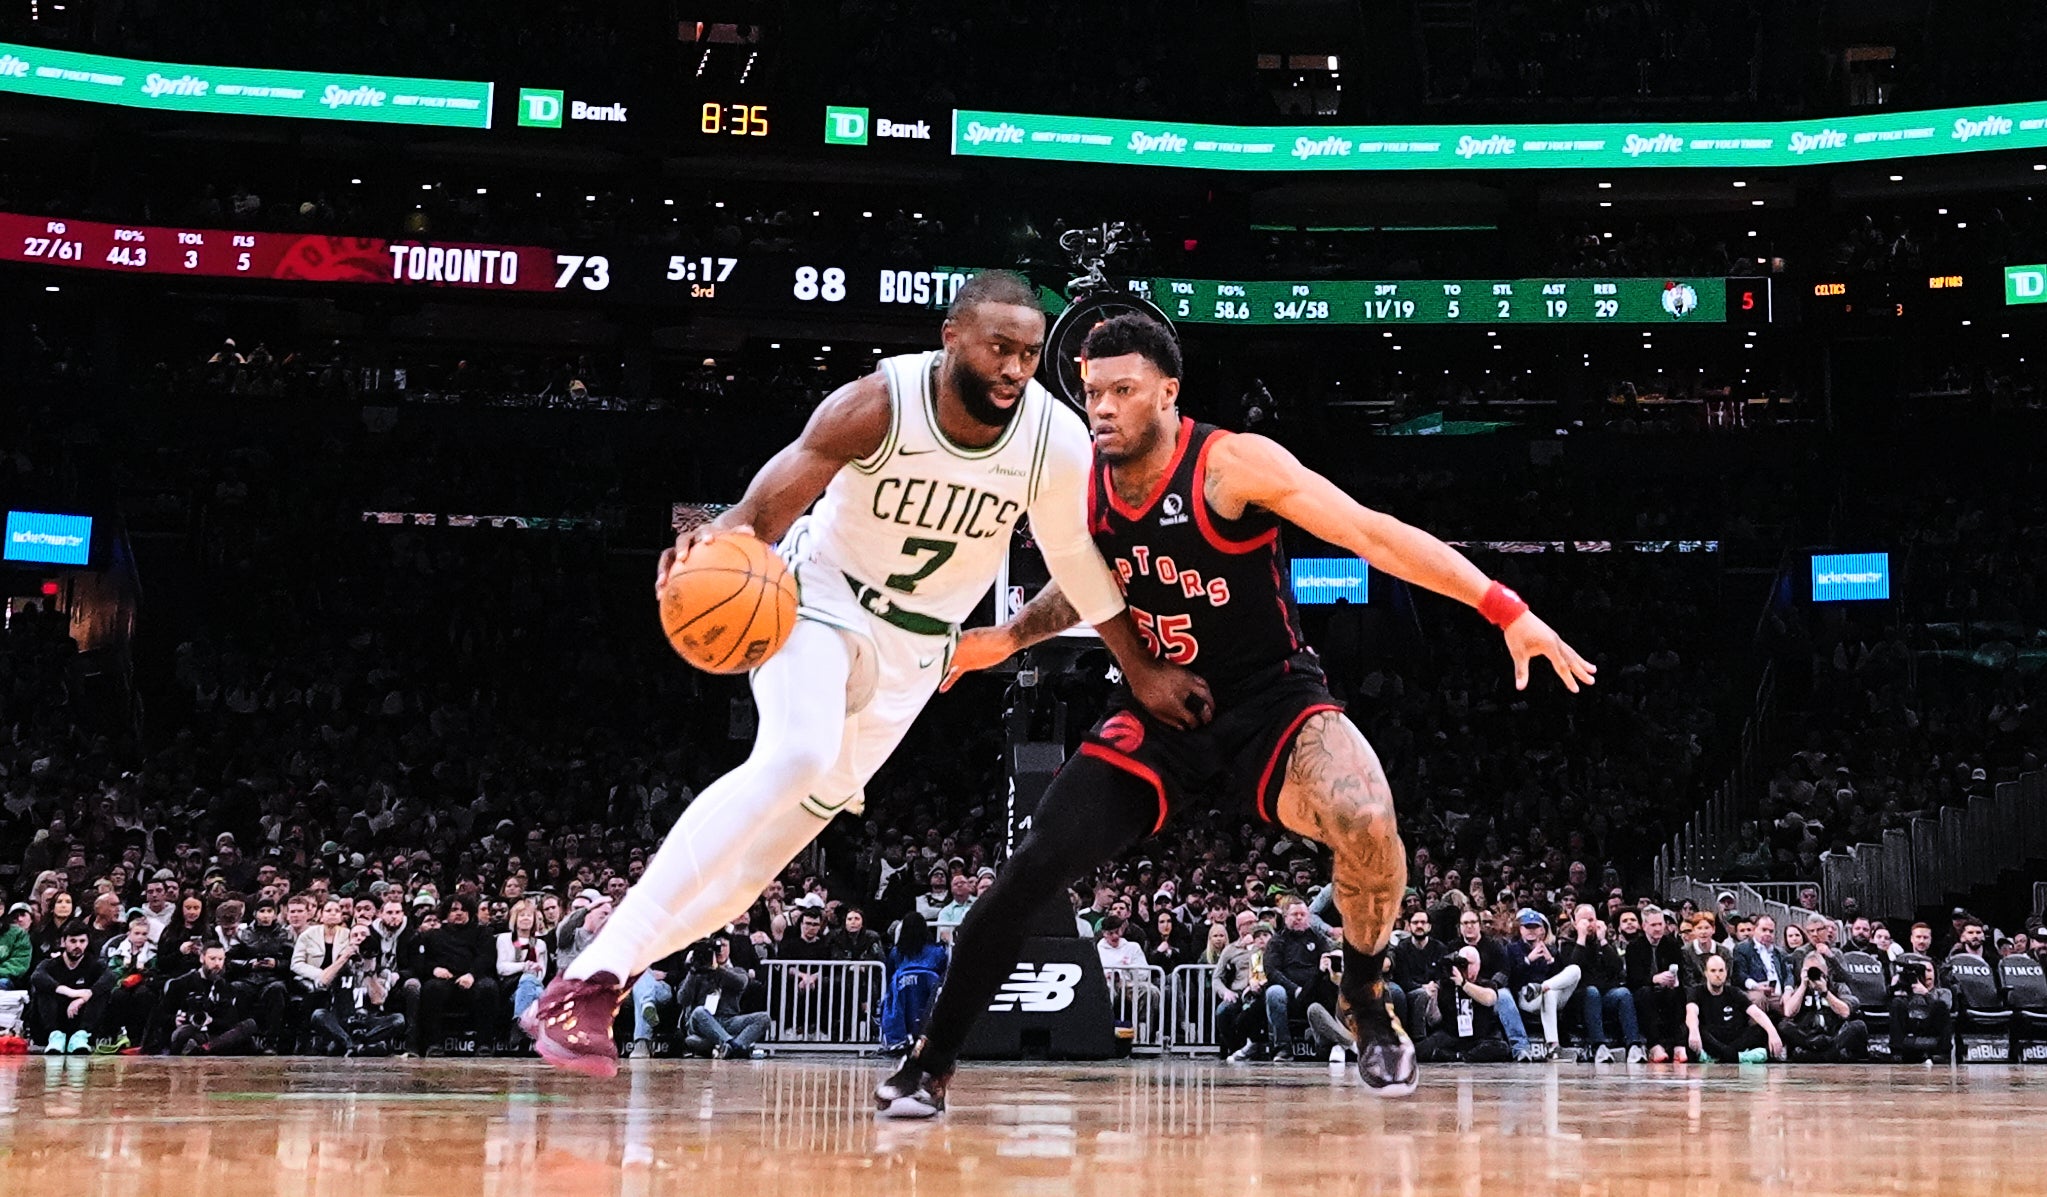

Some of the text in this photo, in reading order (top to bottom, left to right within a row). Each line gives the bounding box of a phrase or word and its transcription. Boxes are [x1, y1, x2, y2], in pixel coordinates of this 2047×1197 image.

[0, 54, 29, 77] ite
[141, 73, 209, 97] Sprite
[320, 84, 387, 109] Sprite
[523, 95, 627, 122] TD Bank
[702, 103, 767, 136] 8:35
[830, 112, 930, 139] TD Bank
[964, 121, 1025, 145] Sprite
[1952, 115, 2013, 142] Sprite
[1127, 131, 1188, 154] Sprite
[1291, 136, 1352, 160] Sprite
[1455, 134, 1516, 159] Sprite
[1622, 133, 1684, 157] Sprite
[1788, 129, 1848, 154] Sprite
[47, 222, 255, 247] FG FG% TOL FLS
[23, 237, 251, 271] 27/61 44.3 3 5
[389, 245, 518, 285] TORONTO
[554, 255, 610, 290] 73
[667, 256, 738, 282] 5:17
[691, 284, 715, 298] 3rd
[794, 266, 974, 305] 88 BOSTO
[1129, 280, 1617, 297] FLS TOL FG% FG 3PT TO STL AST REB
[1814, 284, 1845, 296] CELTICS
[2008, 271, 2043, 297] TD
[1178, 299, 1618, 319] 5 58.6 34/58 11/19 5 2 19 29
[1742, 292, 1754, 310] 5
[873, 477, 1019, 539] CELTICS
[885, 536, 958, 594] 7
[1112, 546, 1230, 607] PTORS
[1129, 605, 1199, 665] 55
[1849, 963, 1881, 974] IMCO
[1952, 965, 1990, 976] PIMCO
[2004, 966, 2043, 976] PIMCO
[444, 1037, 476, 1051] Blue
[1967, 1044, 2009, 1061] jetBlue
